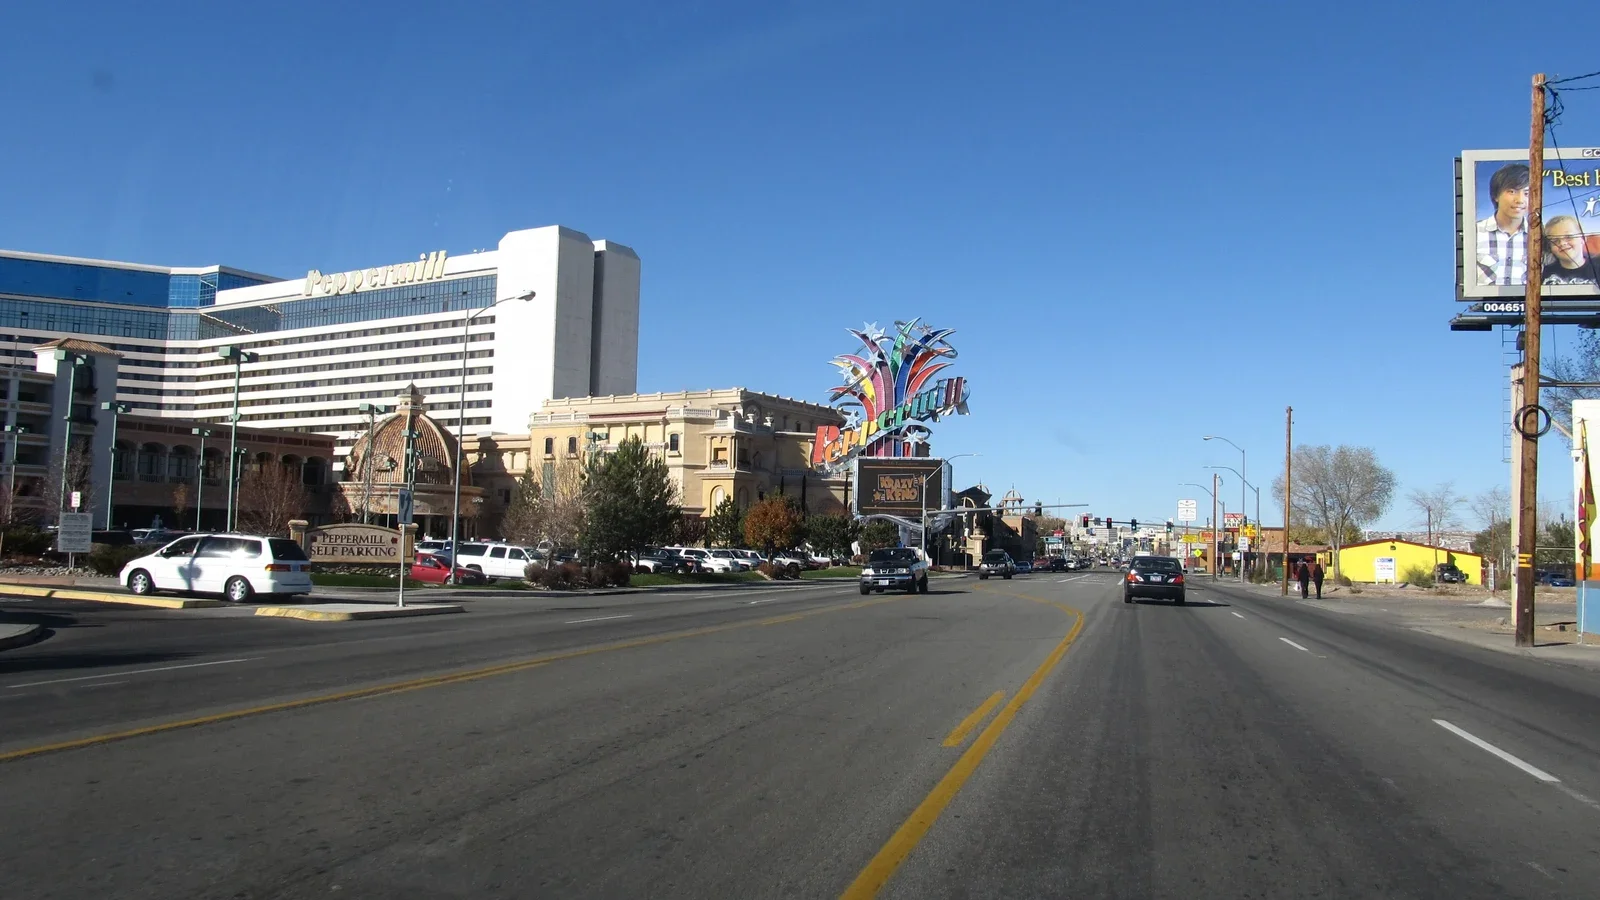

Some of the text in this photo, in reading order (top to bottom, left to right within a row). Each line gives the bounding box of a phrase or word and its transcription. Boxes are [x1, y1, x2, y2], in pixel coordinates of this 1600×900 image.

[303, 249, 448, 297] Peppermill
[1483, 303, 1525, 312] 004651
[812, 376, 967, 464] Peppermill
[885, 487, 918, 501] KENO
[322, 534, 386, 546] PEPPERMILL
[310, 546, 397, 557] SELF PARKING
